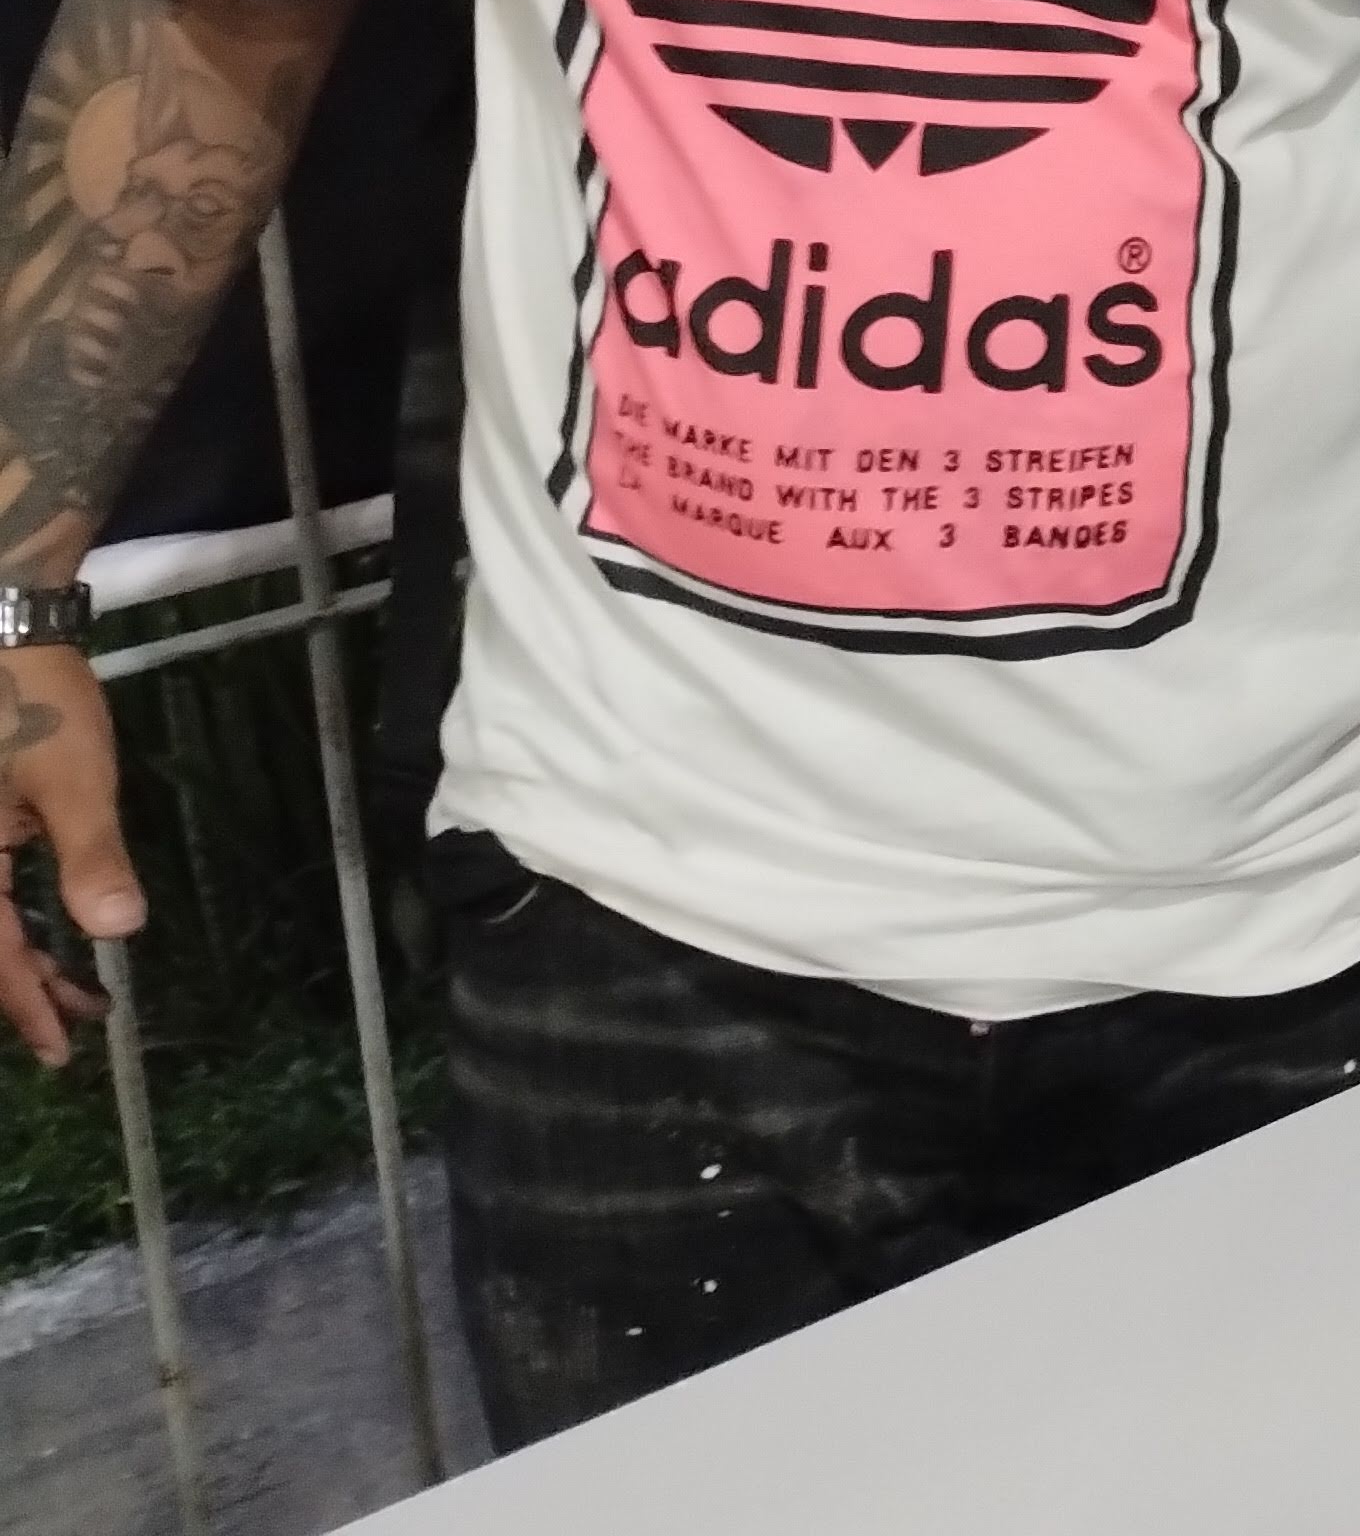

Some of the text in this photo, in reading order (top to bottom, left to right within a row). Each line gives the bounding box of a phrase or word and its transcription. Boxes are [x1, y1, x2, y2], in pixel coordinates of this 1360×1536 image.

[613, 238, 1164, 394] adidas
[661, 416, 752, 463] MARKE
[774, 444, 834, 472] MIT
[855, 448, 920, 474] DEN
[944, 449, 960, 473] 3
[985, 442, 1136, 474] STREIFEN
[666, 454, 756, 503] BRAND
[775, 484, 858, 513] WITH
[881, 485, 940, 512] THE
[963, 486, 980, 510] 3
[1006, 481, 1134, 512] STRIPES
[670, 493, 786, 545] MARQUE
[825, 525, 895, 553] AUX
[938, 522, 956, 549] 3
[1001, 518, 1129, 550] BANDES
